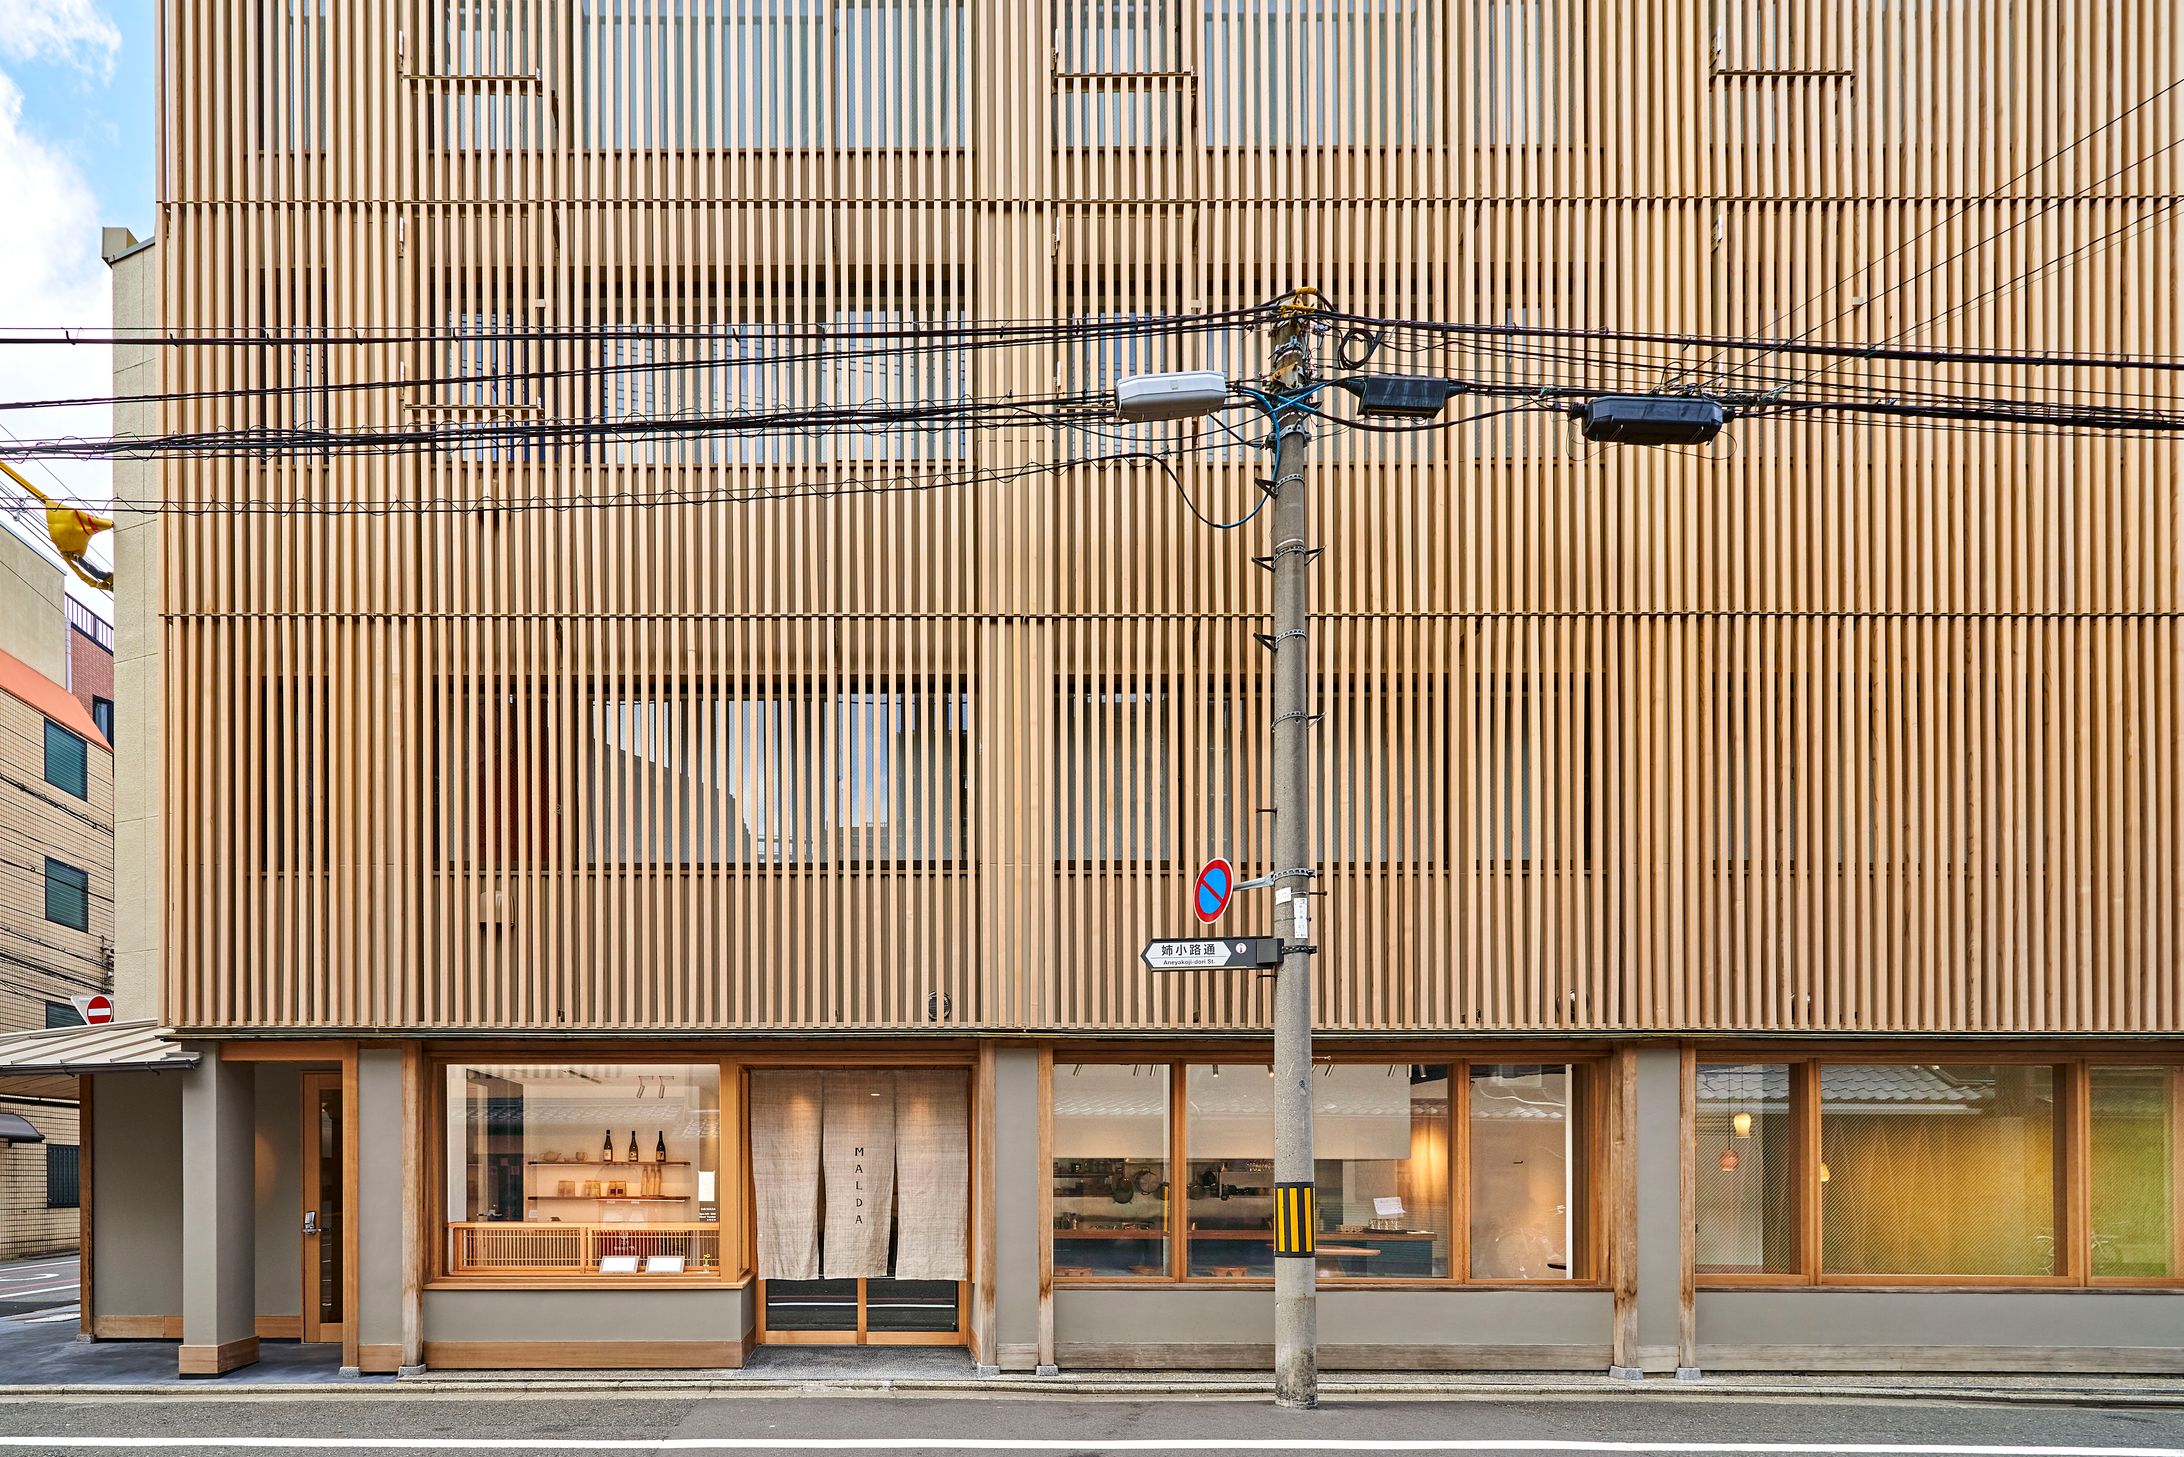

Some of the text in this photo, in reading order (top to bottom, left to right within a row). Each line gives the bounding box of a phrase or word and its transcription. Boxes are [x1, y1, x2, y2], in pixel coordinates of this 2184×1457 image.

[1161, 943, 1216, 957] 姉小路通
[854, 1147, 864, 1225] MALDA
